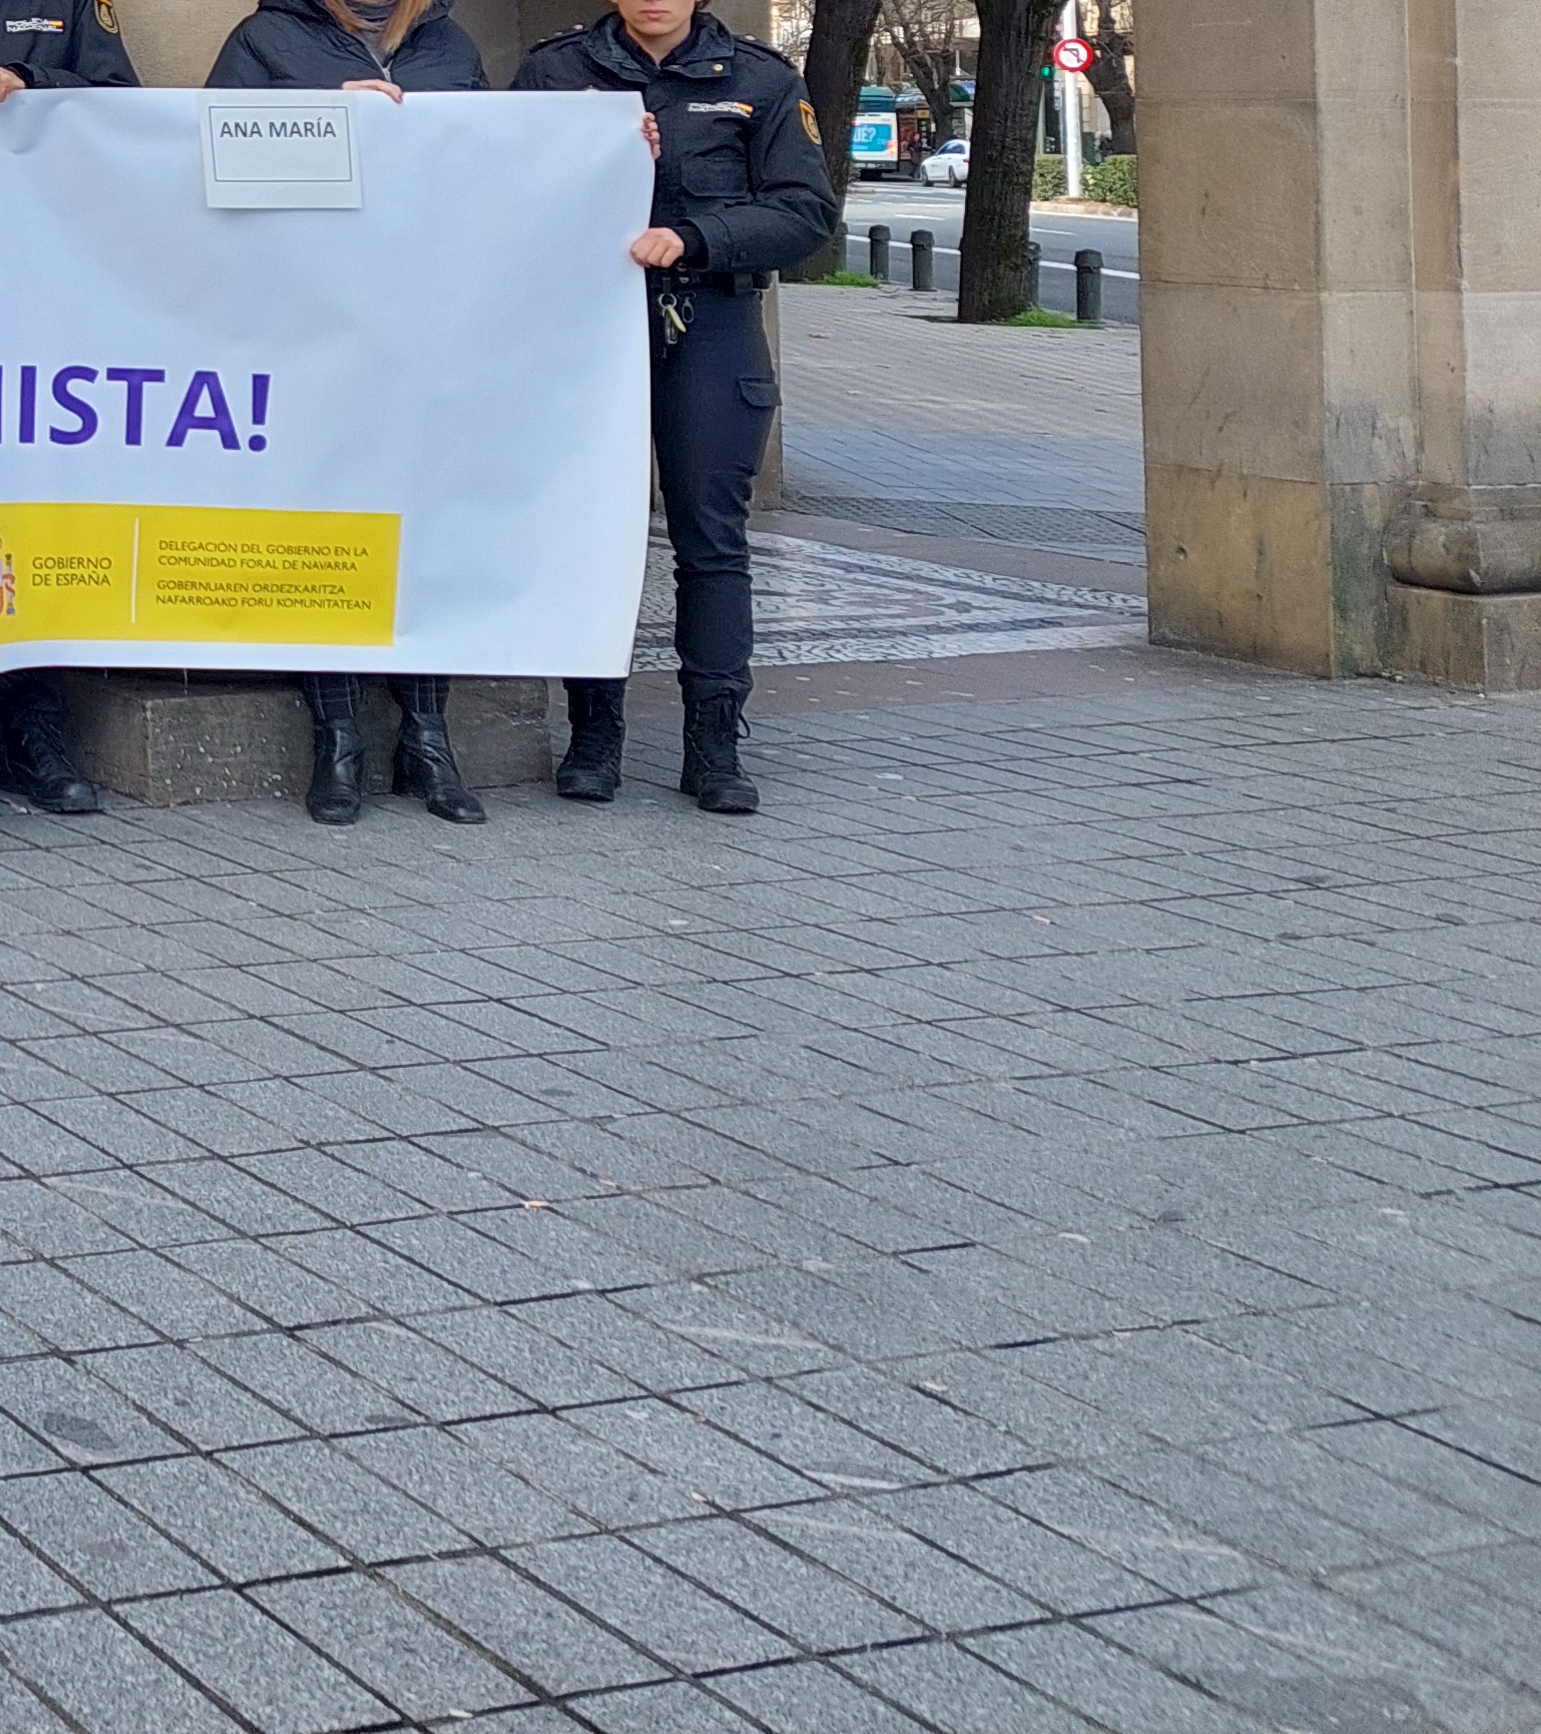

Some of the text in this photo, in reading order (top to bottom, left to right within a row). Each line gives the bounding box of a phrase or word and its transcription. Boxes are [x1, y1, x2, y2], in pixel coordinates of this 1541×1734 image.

[219, 116, 337, 138] ANA MARÍA
[158, 540, 369, 557] DELEGACIÓN DEL GOBIERNO EN LA
[32, 556, 112, 569] GOBIERNO
[158, 555, 357, 572] COMUNIDAD FORAL DE NAVARRA
[32, 571, 111, 586] DE ESPAÑA
[156, 579, 346, 595] GOBERNUAREN ORDEZKARITZA
[155, 594, 372, 610] NAFARROAKO FORU KOMUNITATEAN
